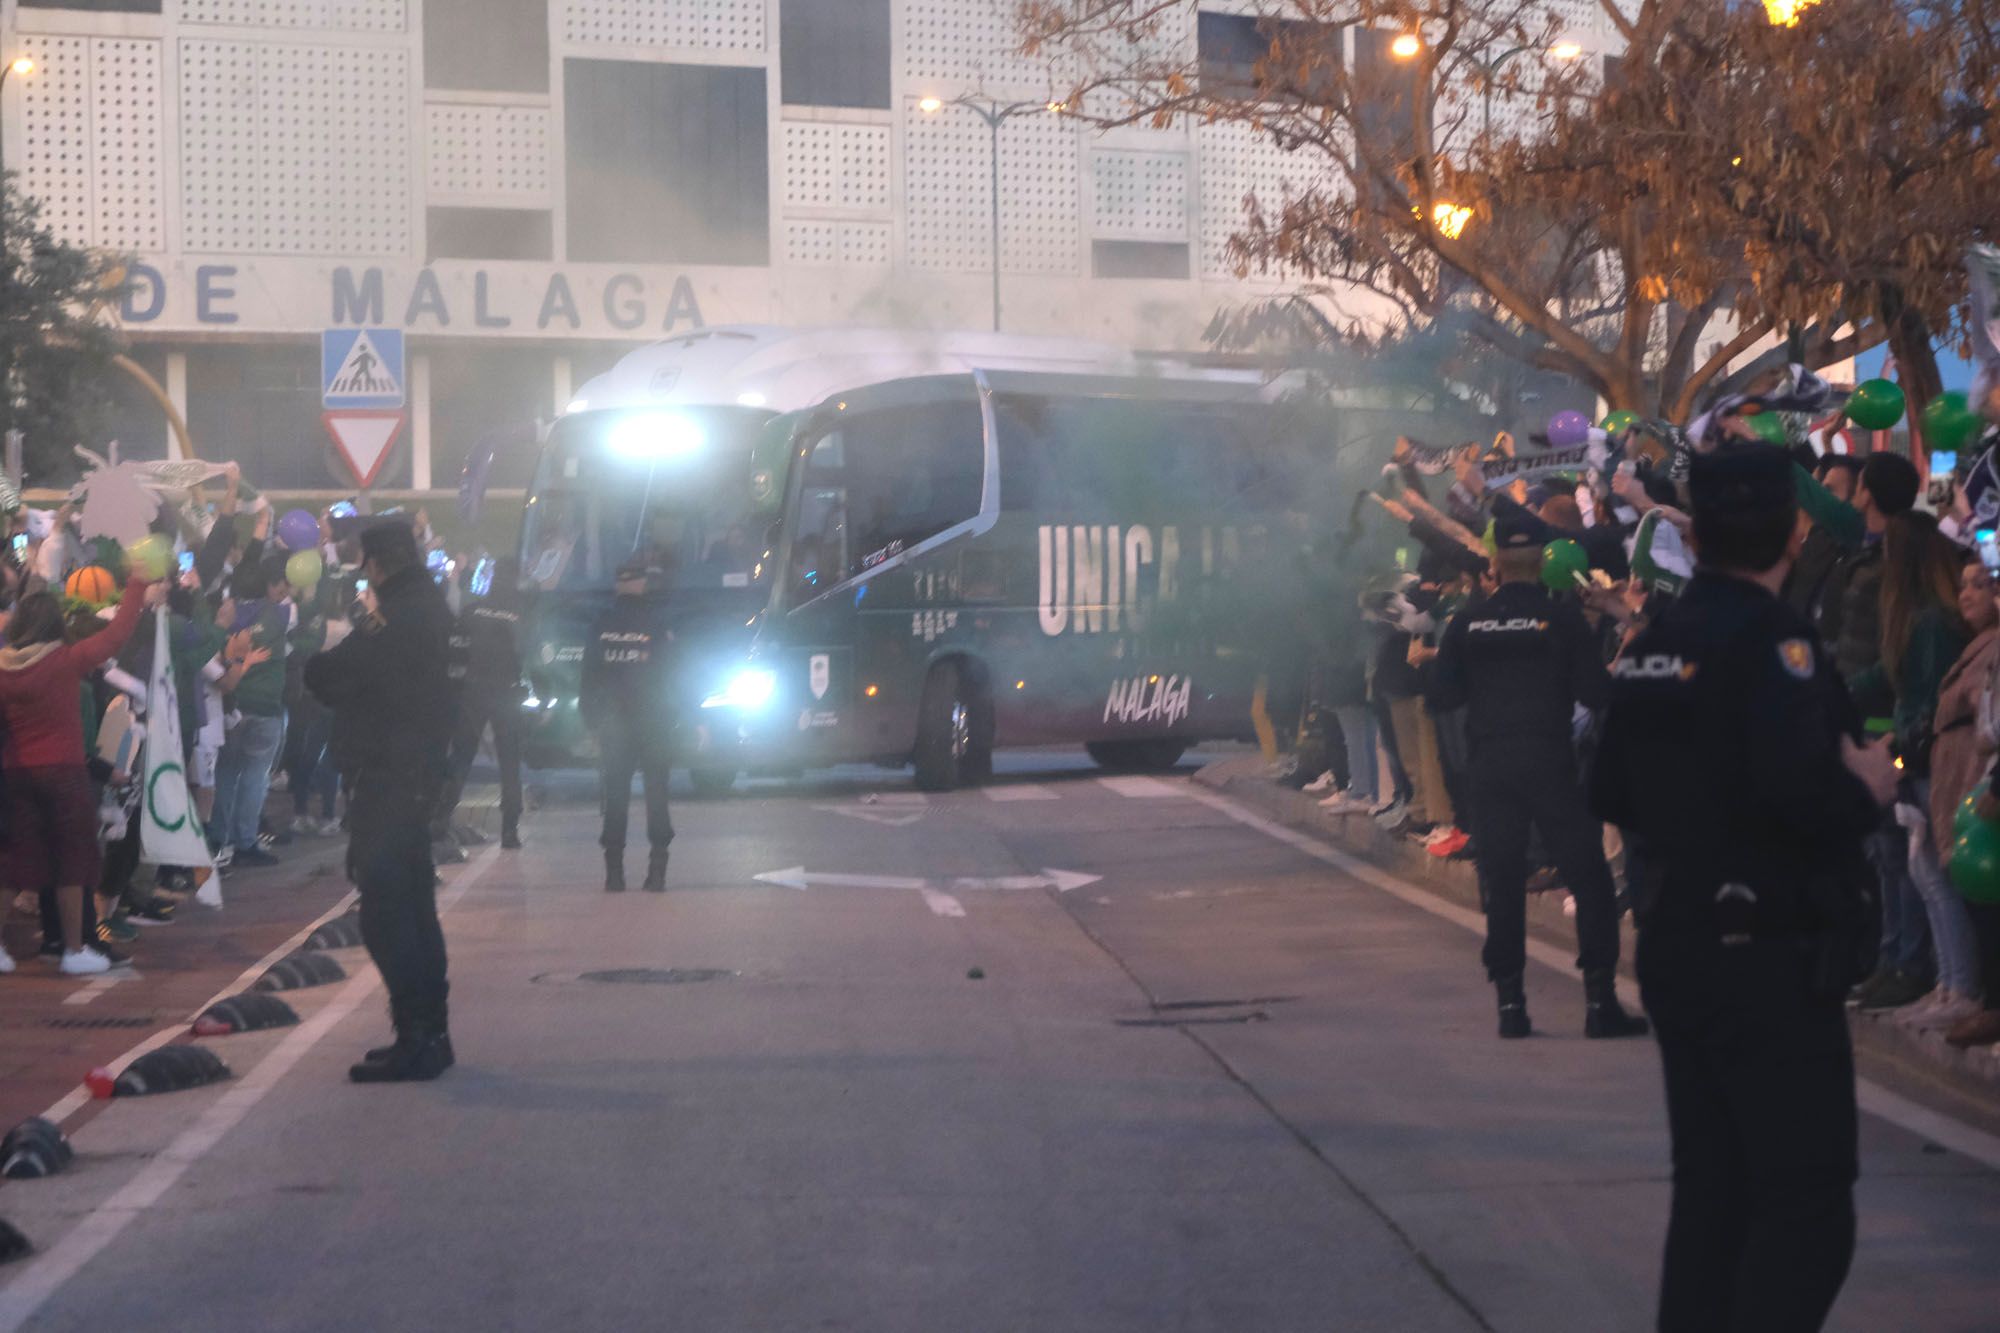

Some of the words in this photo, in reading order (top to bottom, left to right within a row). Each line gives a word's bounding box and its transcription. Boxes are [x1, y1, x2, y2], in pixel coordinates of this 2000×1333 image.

[119, 264, 239, 324] DE
[331, 267, 705, 333] MALAGA
[1468, 617, 1538, 632] POLICIA
